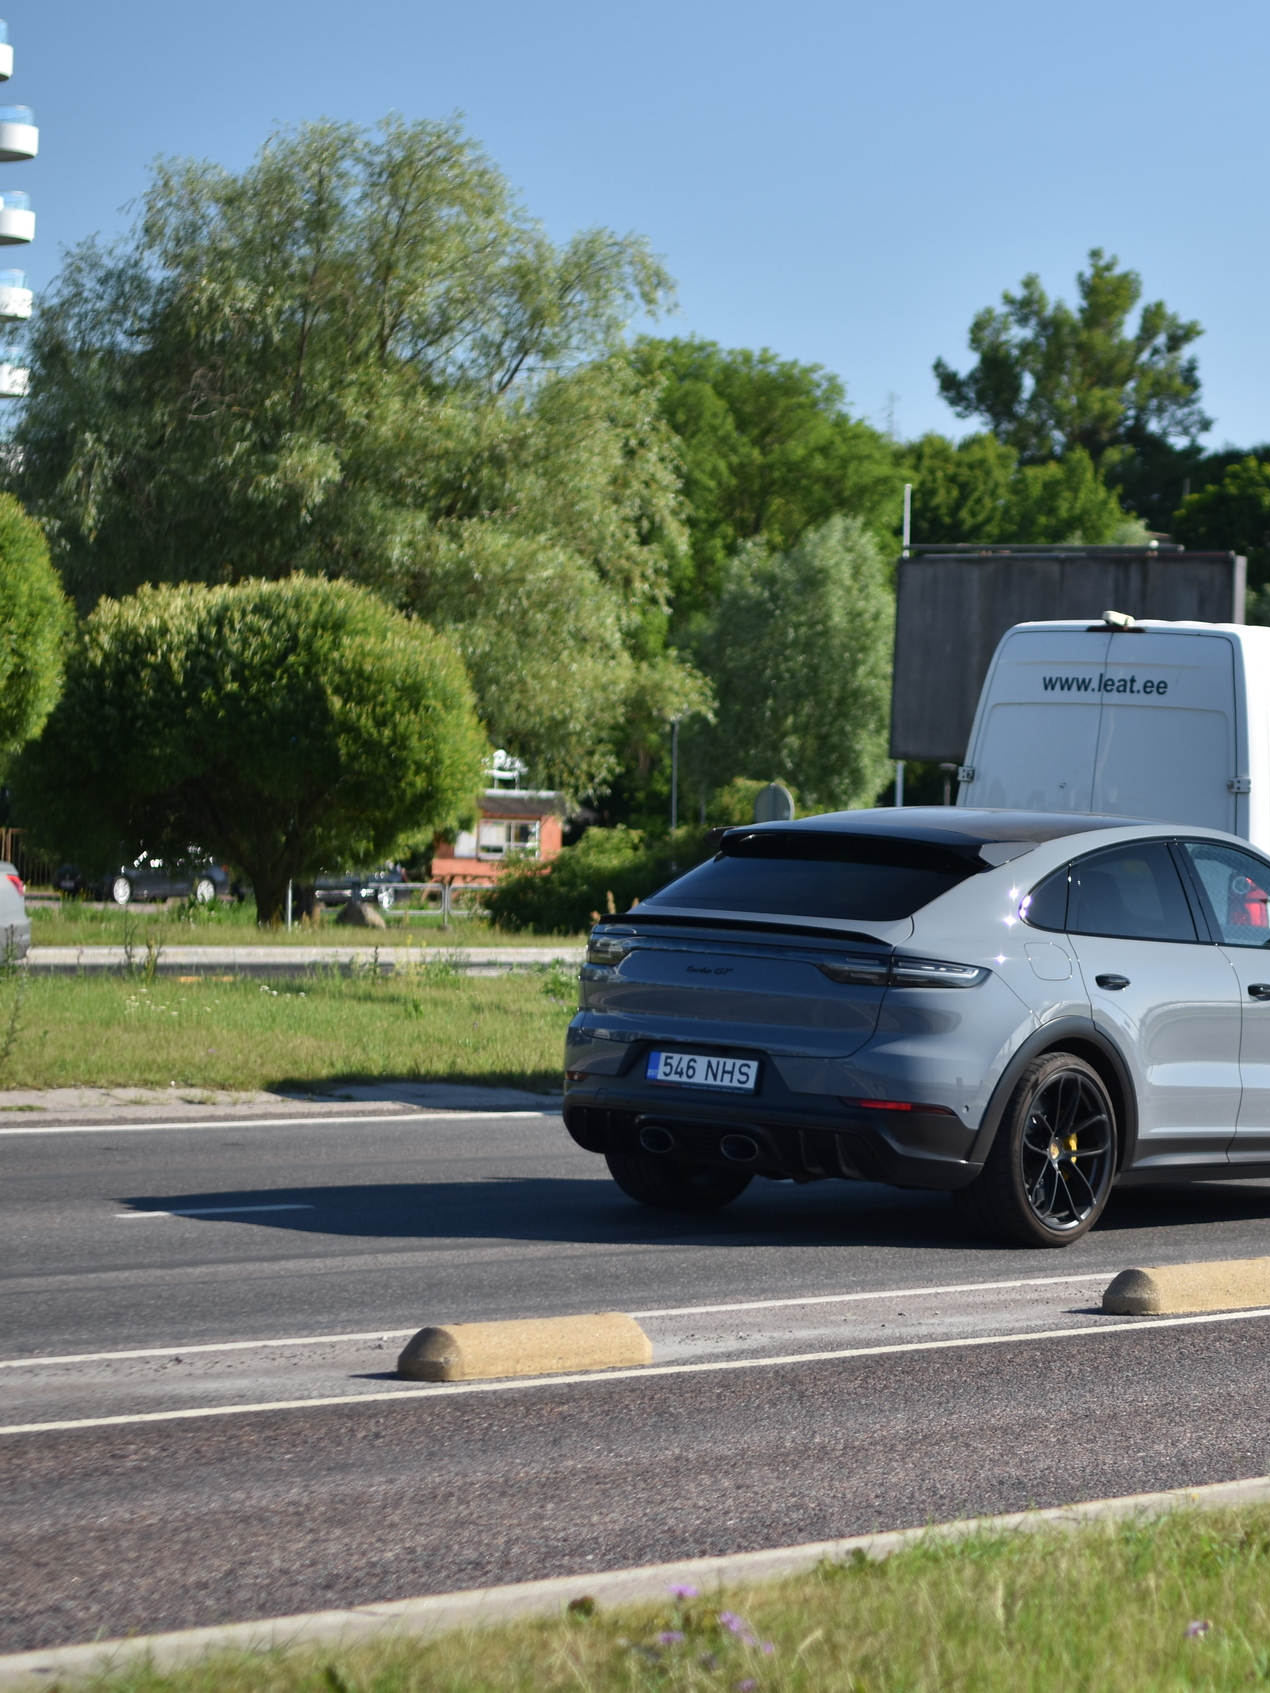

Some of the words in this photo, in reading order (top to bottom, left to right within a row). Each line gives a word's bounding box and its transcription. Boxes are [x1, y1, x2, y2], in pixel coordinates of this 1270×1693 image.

[1042, 673, 1169, 696] www.leat.ee
[662, 1055, 697, 1079] 546
[704, 1059, 751, 1085] NHS
